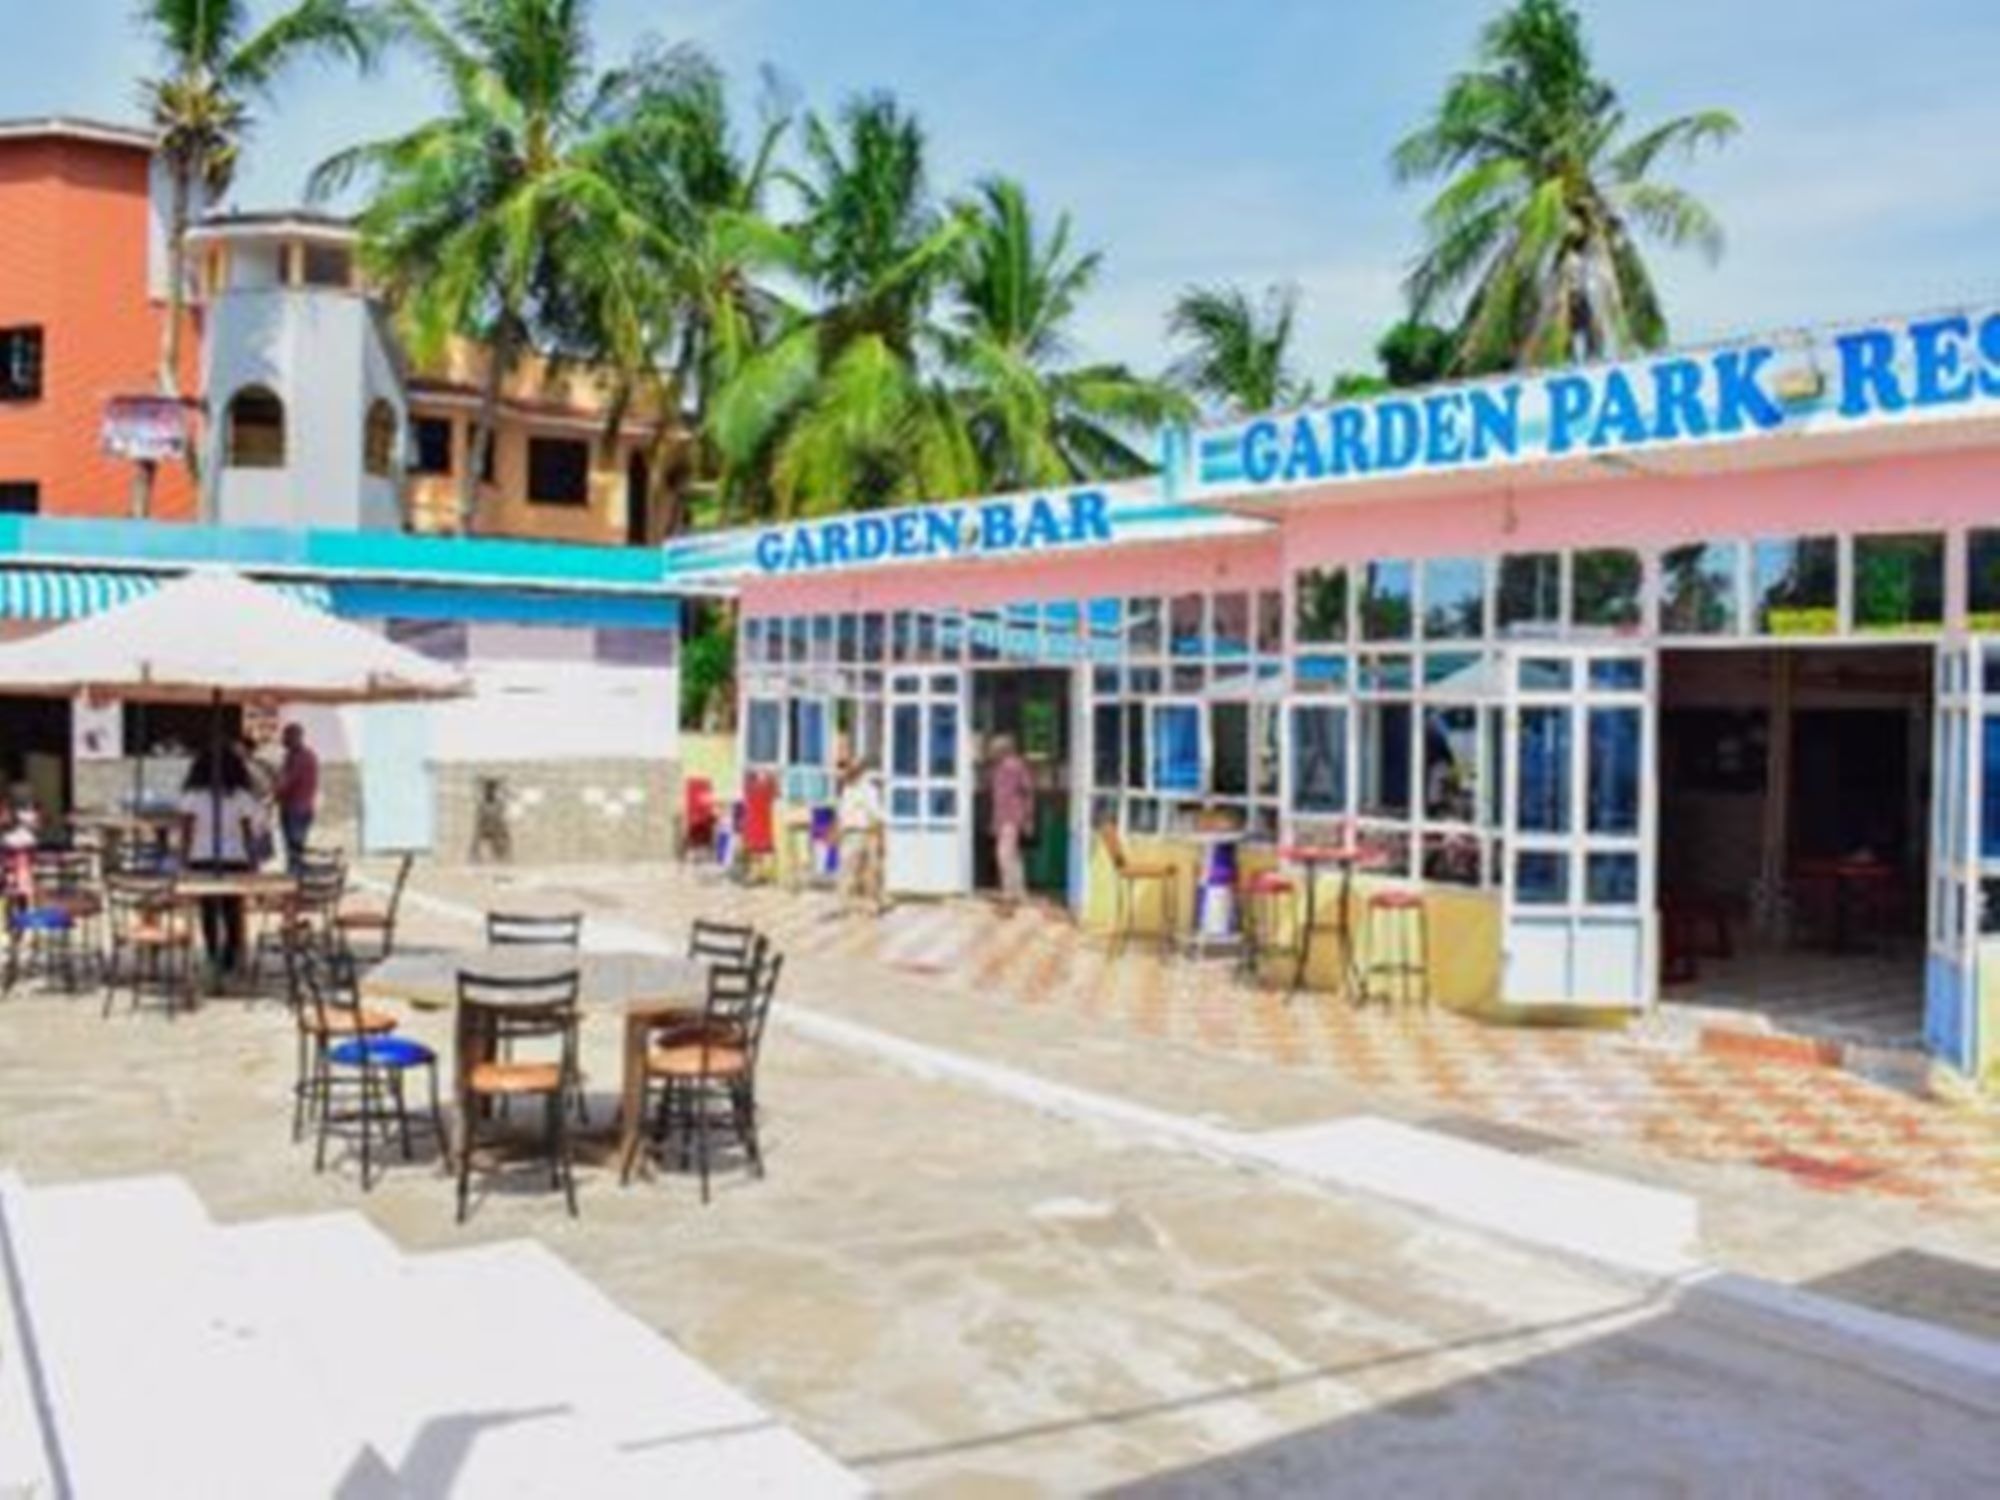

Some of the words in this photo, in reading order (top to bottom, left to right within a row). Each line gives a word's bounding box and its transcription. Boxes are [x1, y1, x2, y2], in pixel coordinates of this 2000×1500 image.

[1241, 383, 1521, 483] GARDEN
[1544, 347, 1784, 452] PARK
[755, 508, 964, 571] GARDEN
[978, 490, 1111, 549] BAR
